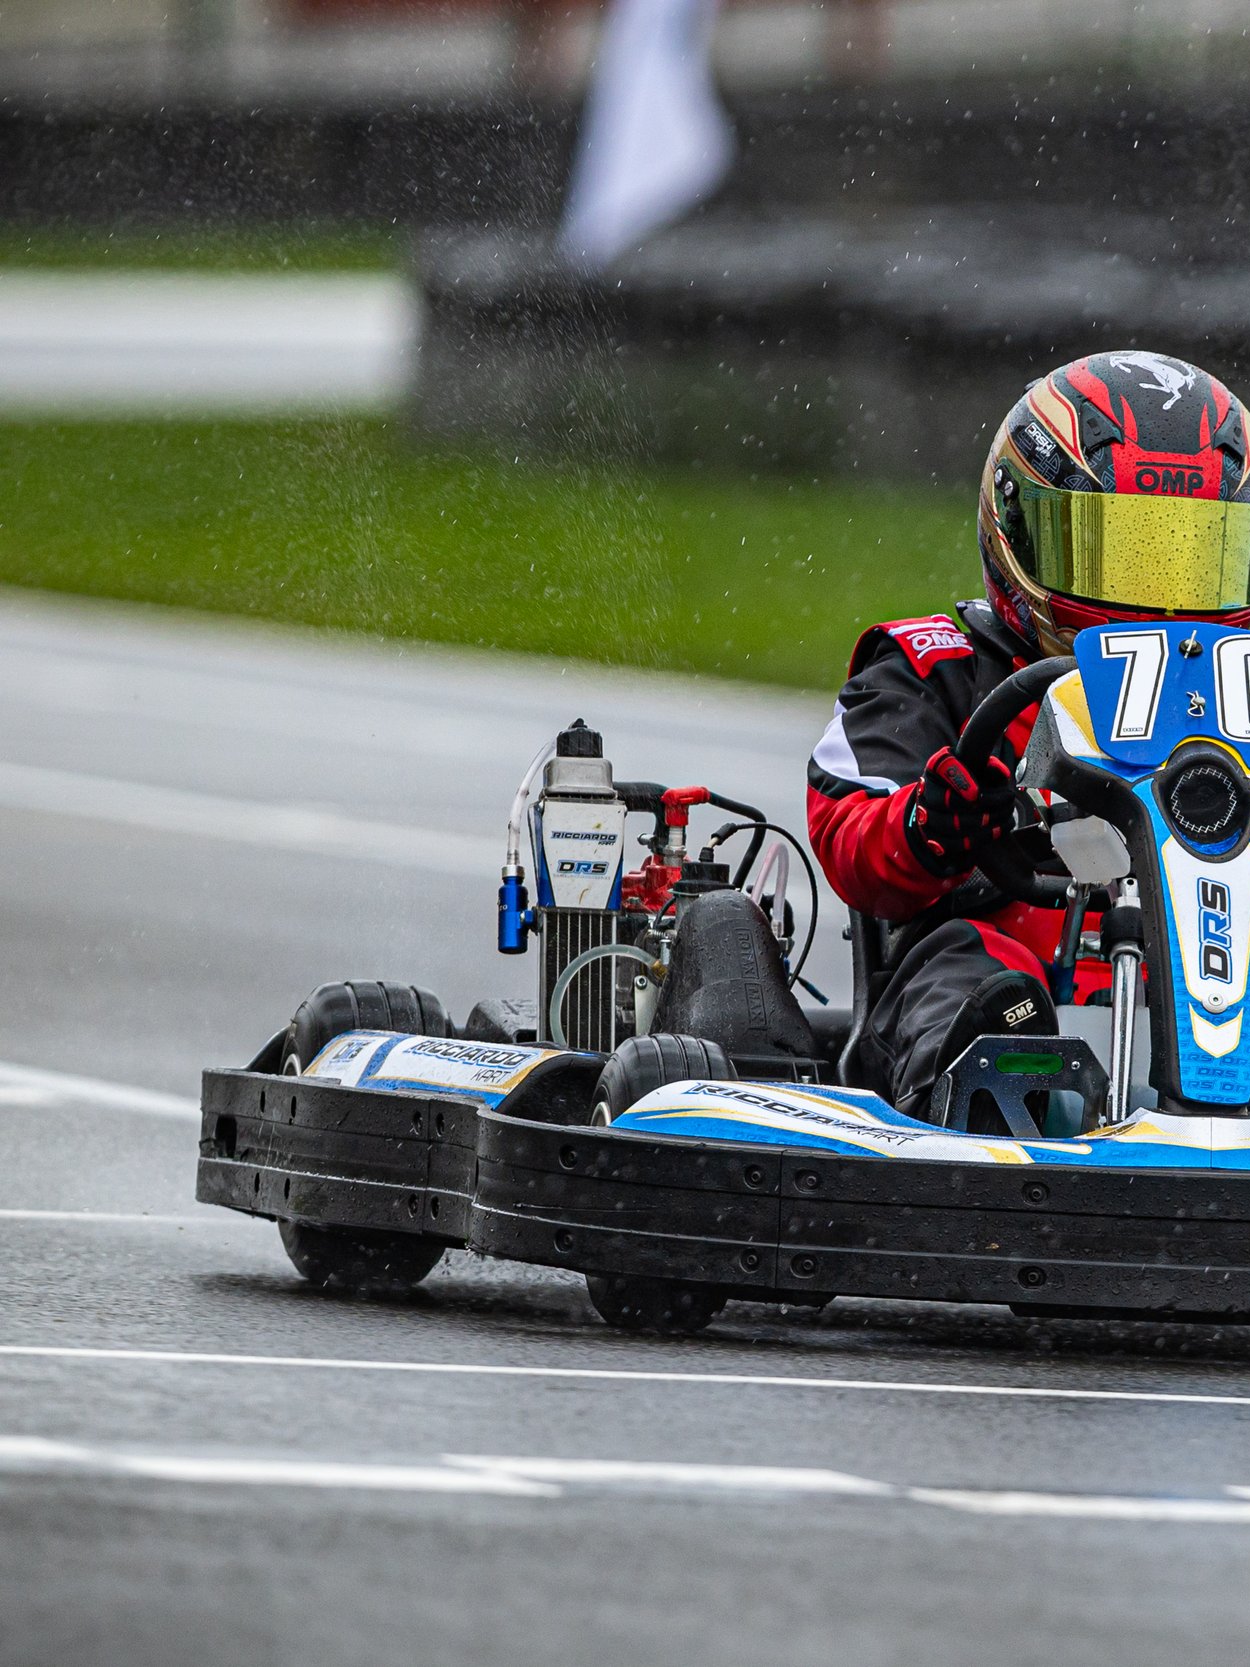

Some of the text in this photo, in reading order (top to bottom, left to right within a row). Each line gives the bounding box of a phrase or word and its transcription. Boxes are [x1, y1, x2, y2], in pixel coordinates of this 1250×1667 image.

[1135, 468, 1203, 495] OMP
[911, 631, 968, 652] OMP
[551, 831, 617, 841] RICCIARDO
[558, 861, 608, 874] DRS
[1199, 879, 1231, 982] DRS
[1005, 1001, 1034, 1024] OMP
[408, 1039, 533, 1068] RICCIARDO
[471, 1068, 512, 1085] KART
